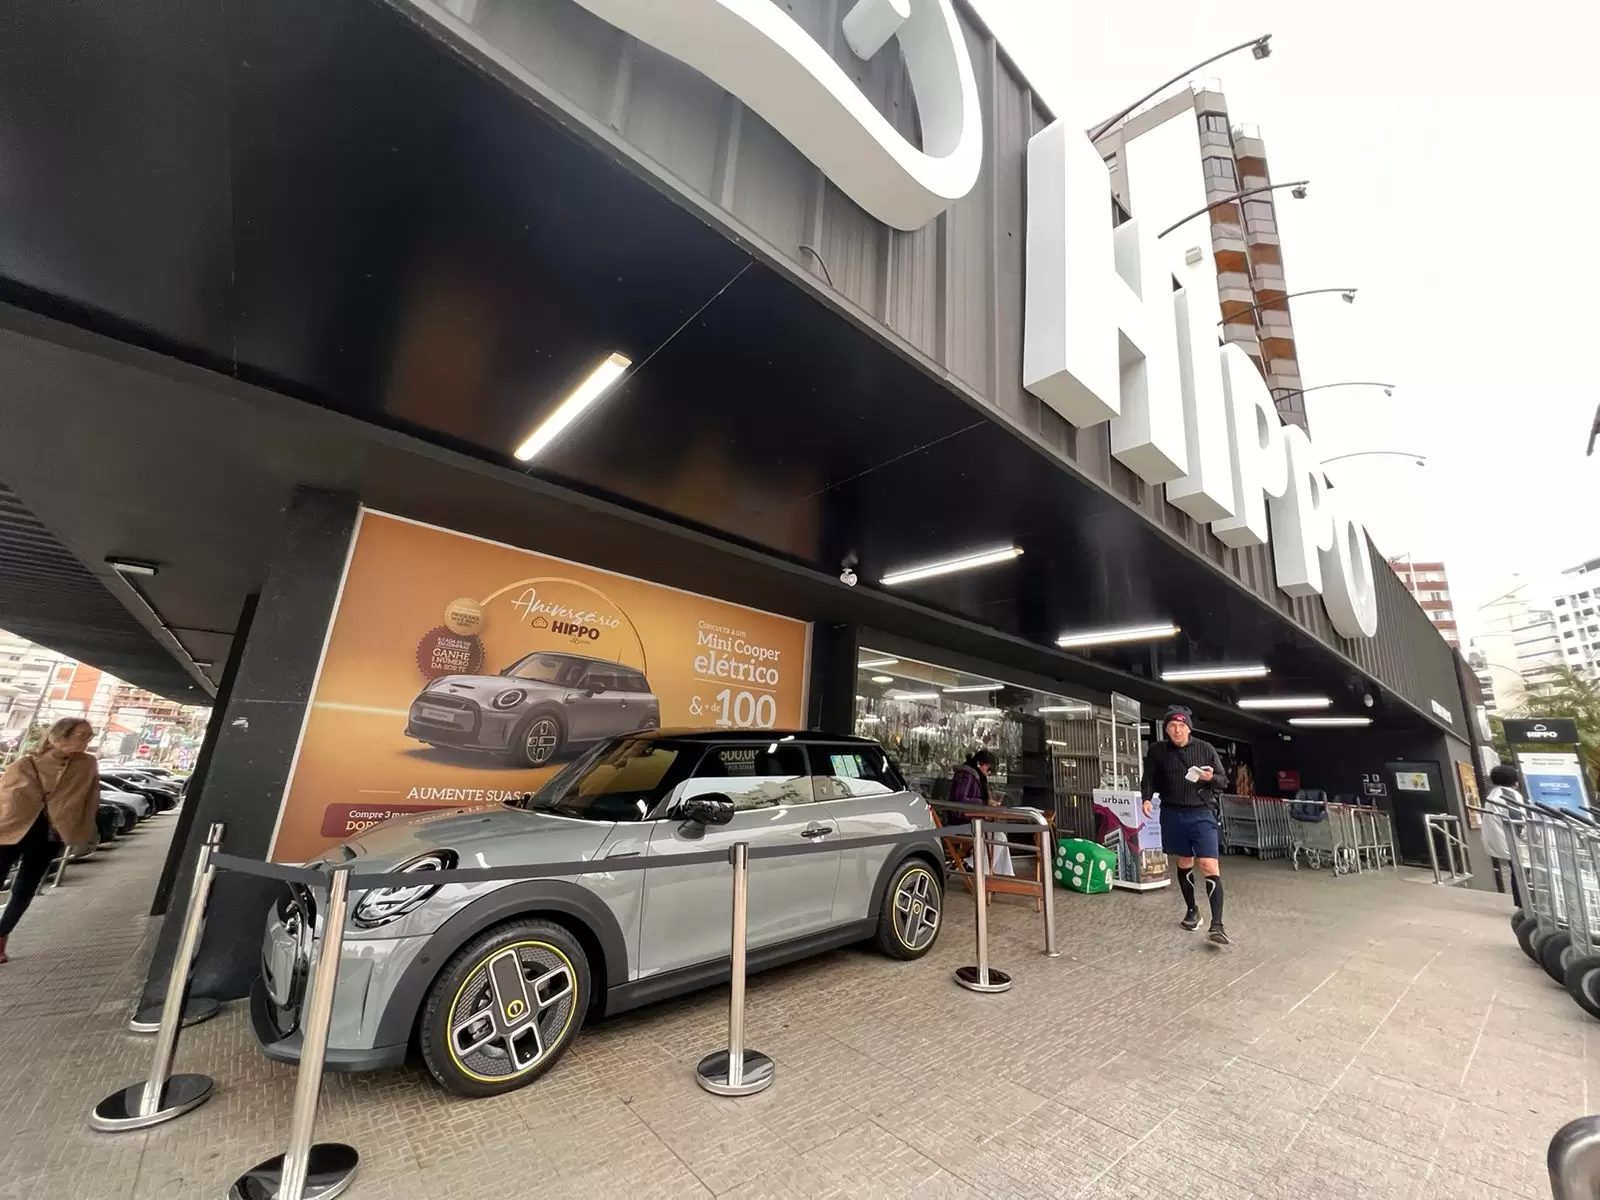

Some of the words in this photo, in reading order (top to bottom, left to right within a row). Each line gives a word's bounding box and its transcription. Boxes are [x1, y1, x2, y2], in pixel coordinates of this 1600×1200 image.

[1023, 117, 1378, 639] HIPPO
[511, 588, 620, 628] Aniversário
[551, 620, 600, 640] HIPPO
[698, 620, 730, 634] Concorra
[696, 630, 732, 652] Mini
[734, 639, 781, 661] Cooper
[432, 648, 471, 661] GANHE
[431, 662, 442, 670] DA
[694, 650, 779, 686] elétrico
[688, 695, 703, 716] &
[710, 702, 720, 713] de
[716, 688, 777, 728] 100
[406, 787, 483, 801] AUMENTE
[485, 789, 521, 802] SUAS
[1101, 795, 1130, 805] urban
[349, 810, 384, 820] Compre
[384, 810, 391, 819] 3
